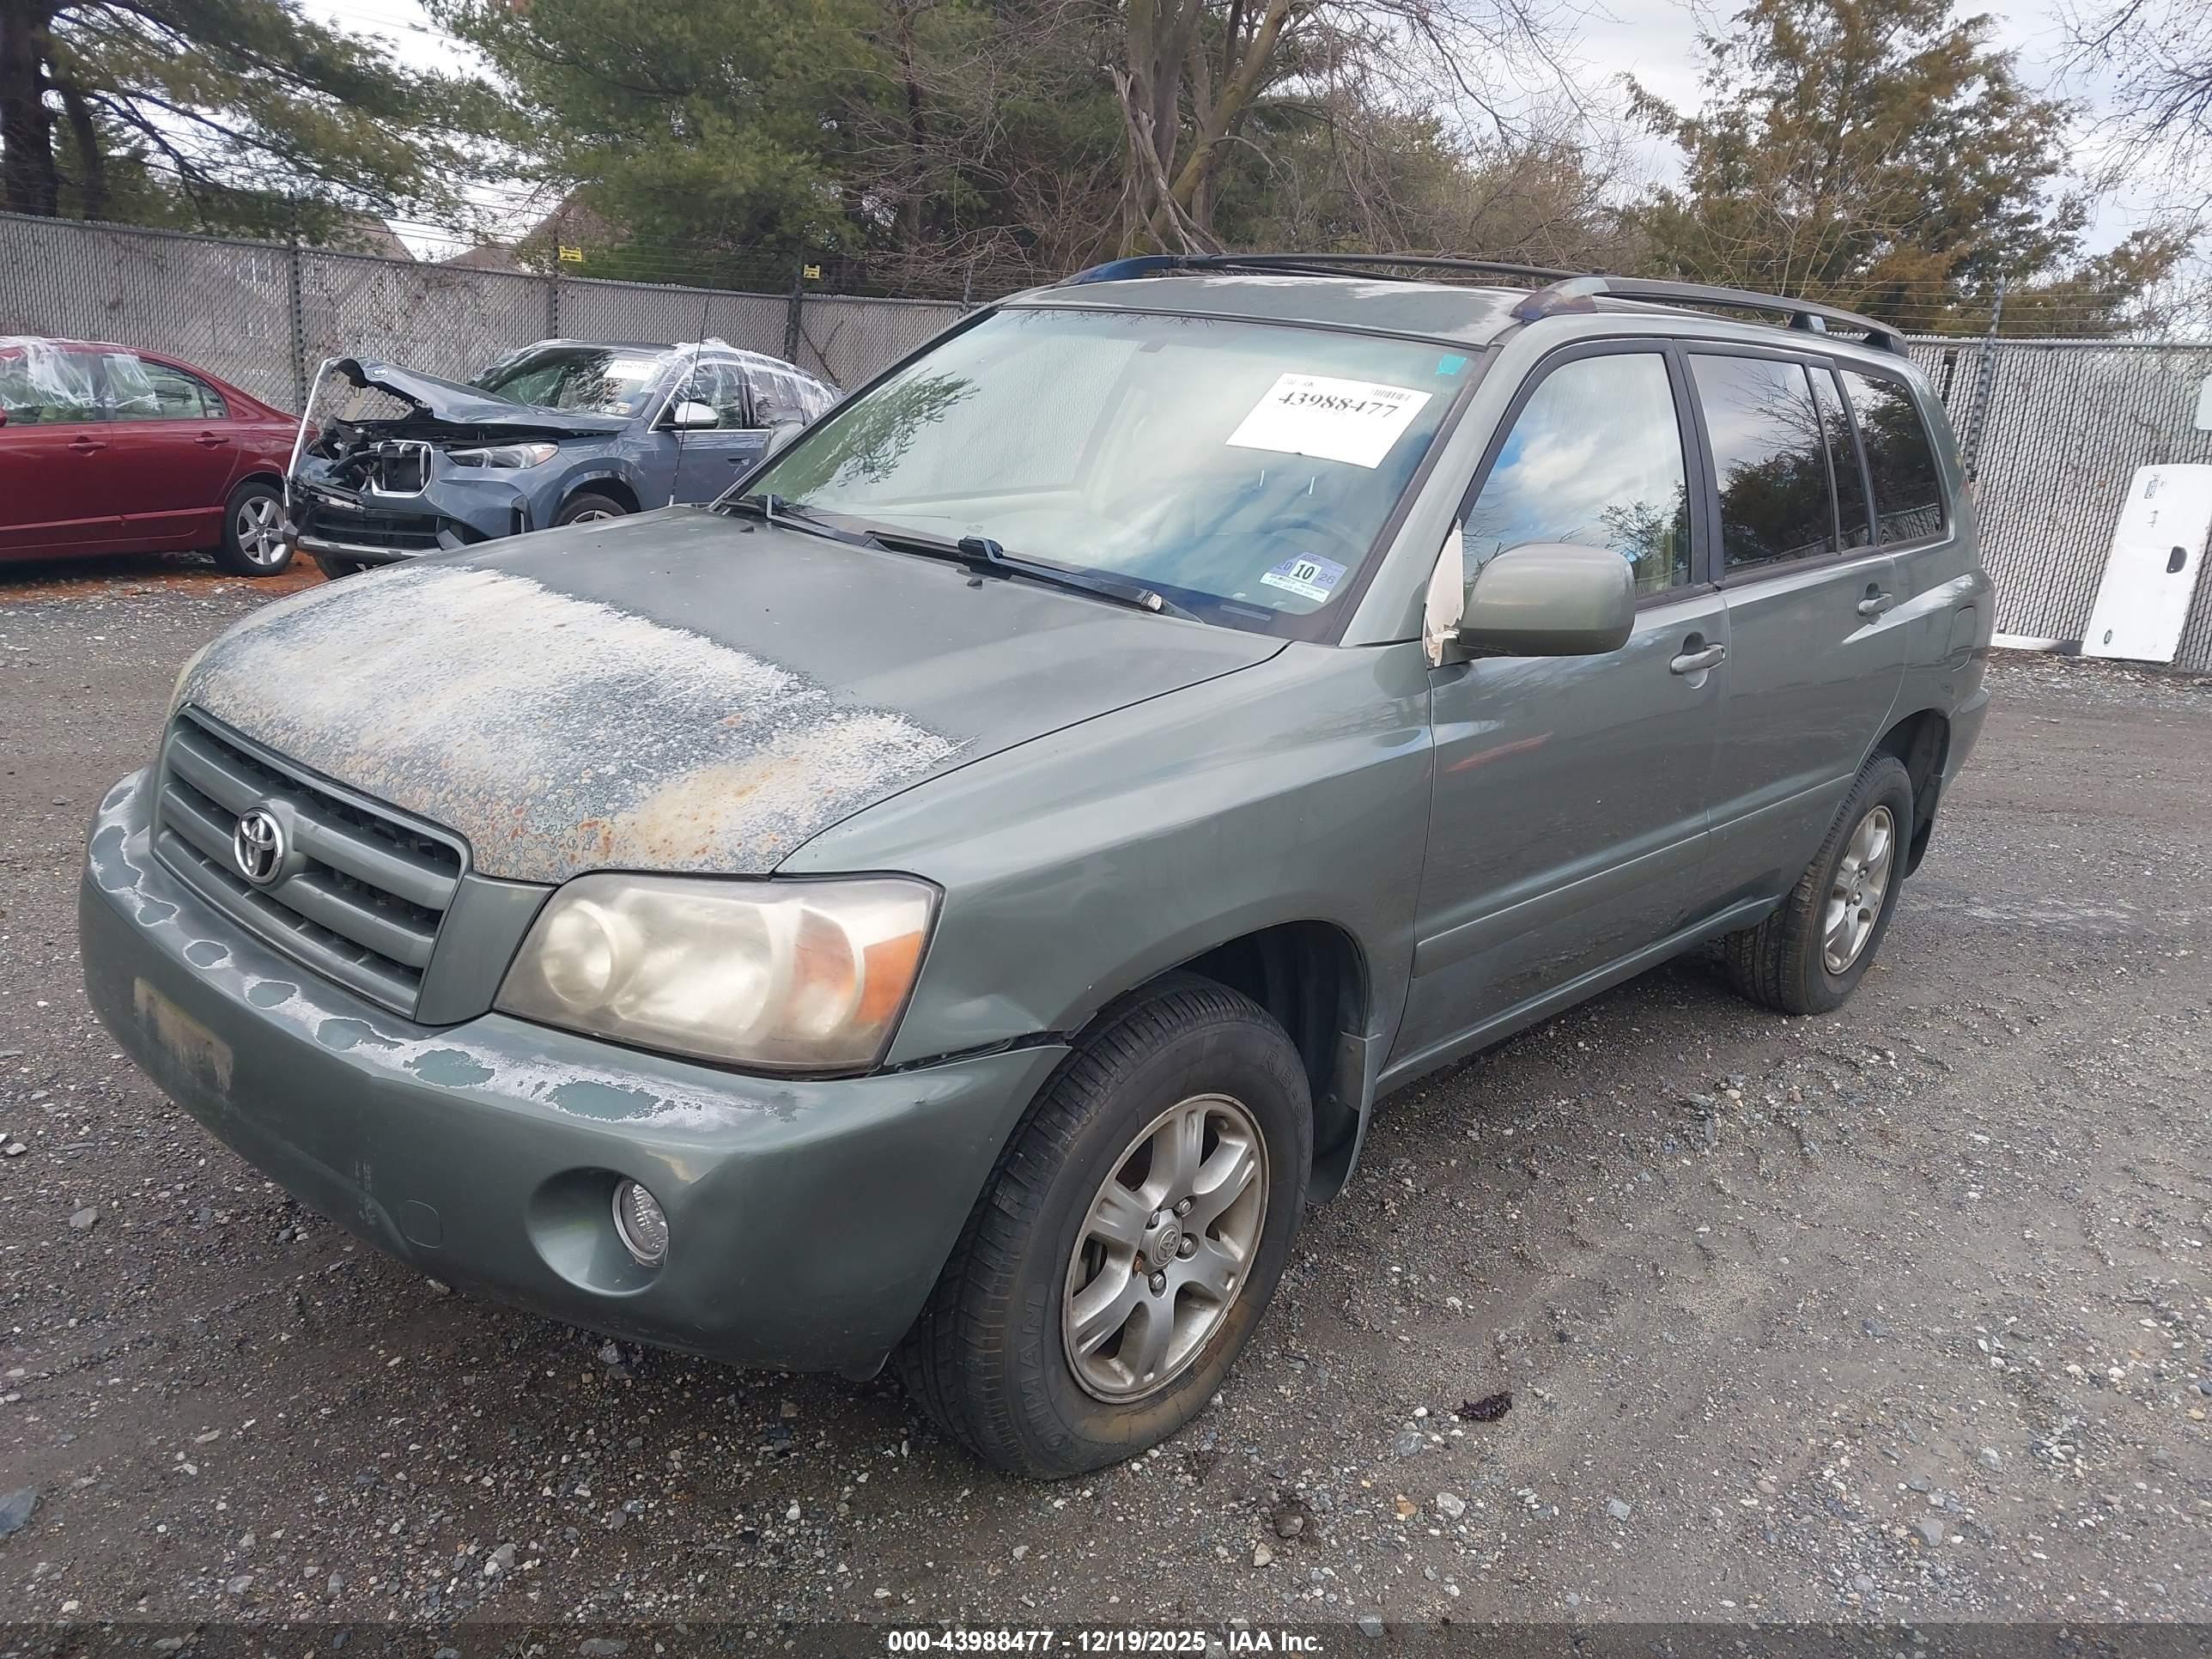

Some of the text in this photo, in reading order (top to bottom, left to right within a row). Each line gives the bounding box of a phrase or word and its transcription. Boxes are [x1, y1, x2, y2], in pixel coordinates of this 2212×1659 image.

[1279, 392, 1398, 417] 43988477
[1293, 563, 1315, 580] 10
[1318, 573, 1335, 584] 26
